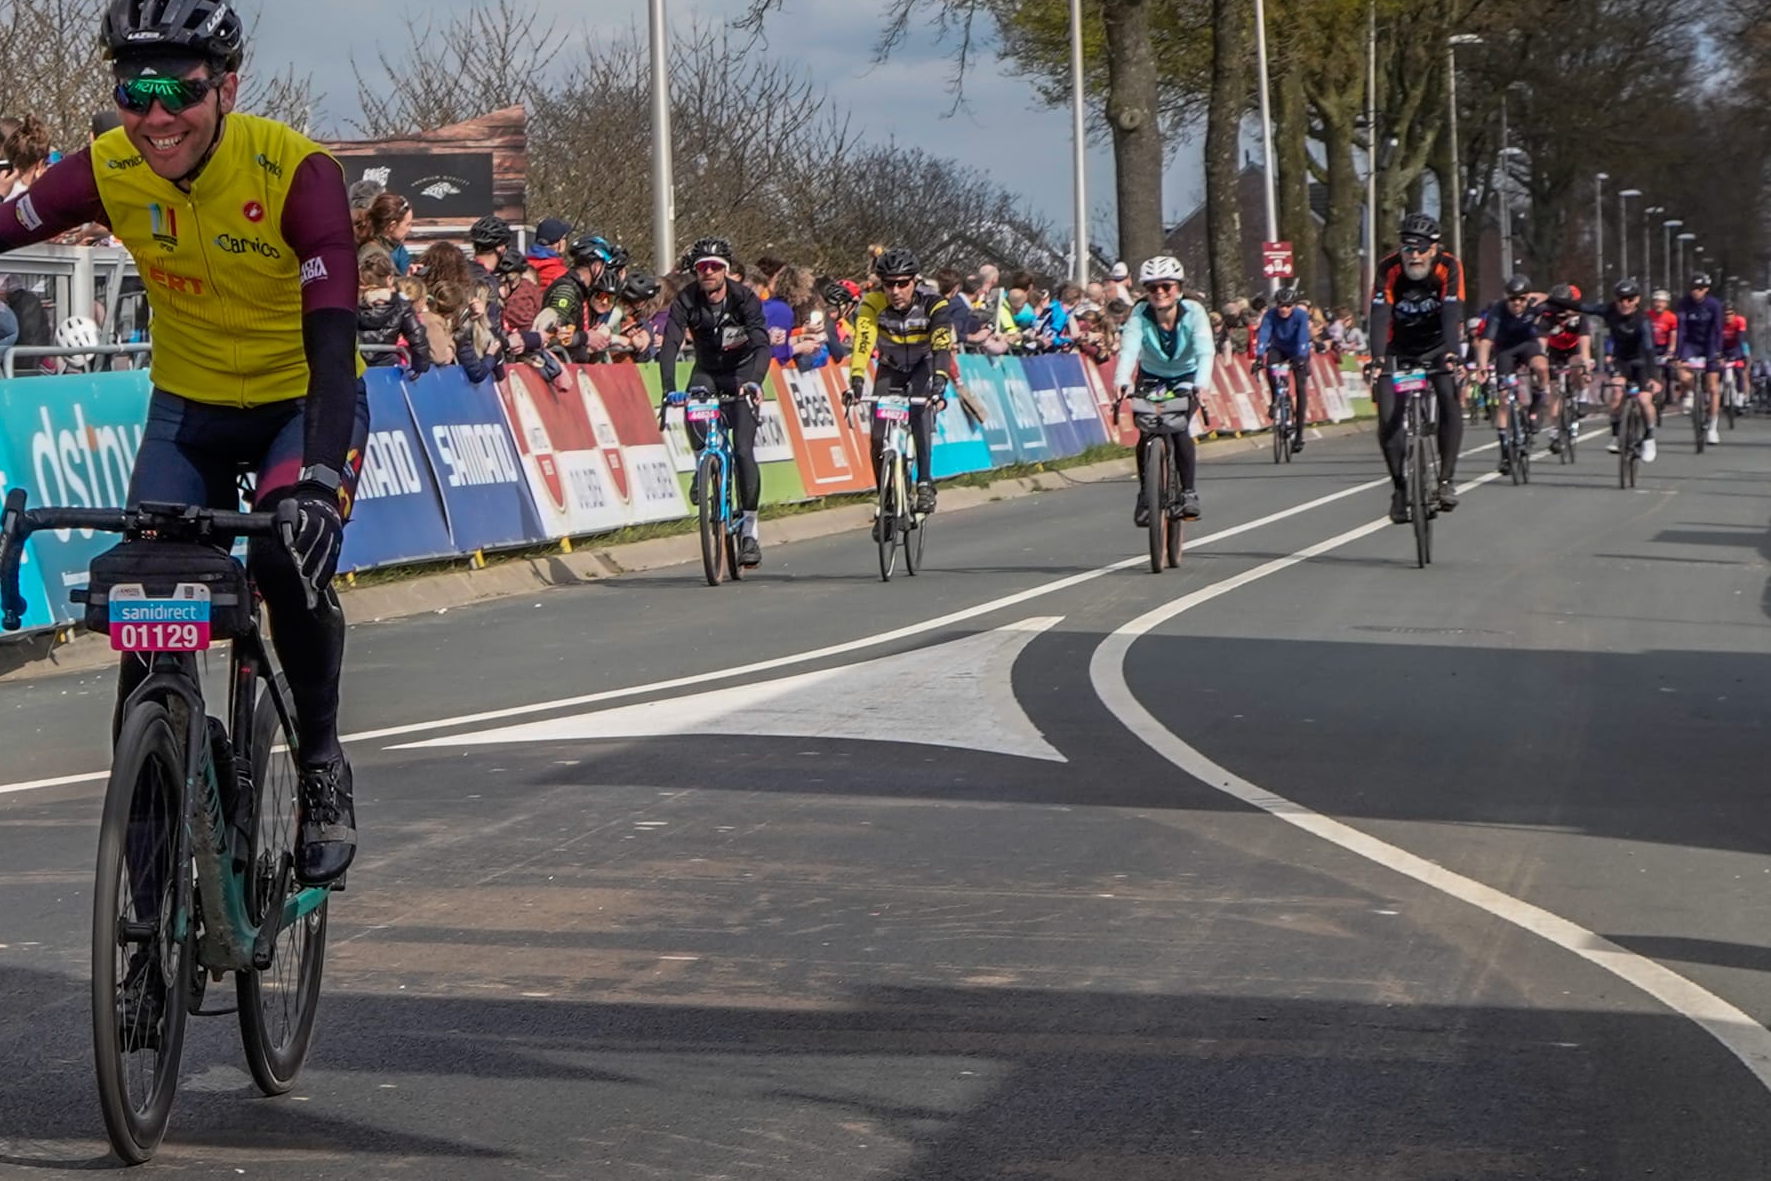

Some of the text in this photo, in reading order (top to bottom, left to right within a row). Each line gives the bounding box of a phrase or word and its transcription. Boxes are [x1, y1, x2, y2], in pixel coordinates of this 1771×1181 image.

[218, 233, 281, 260] Carvico
[789, 379, 834, 428] Boels
[432, 423, 518, 487] SHIMANO
[122, 603, 197, 620] sanidirect
[121, 624, 198, 648] 01129
